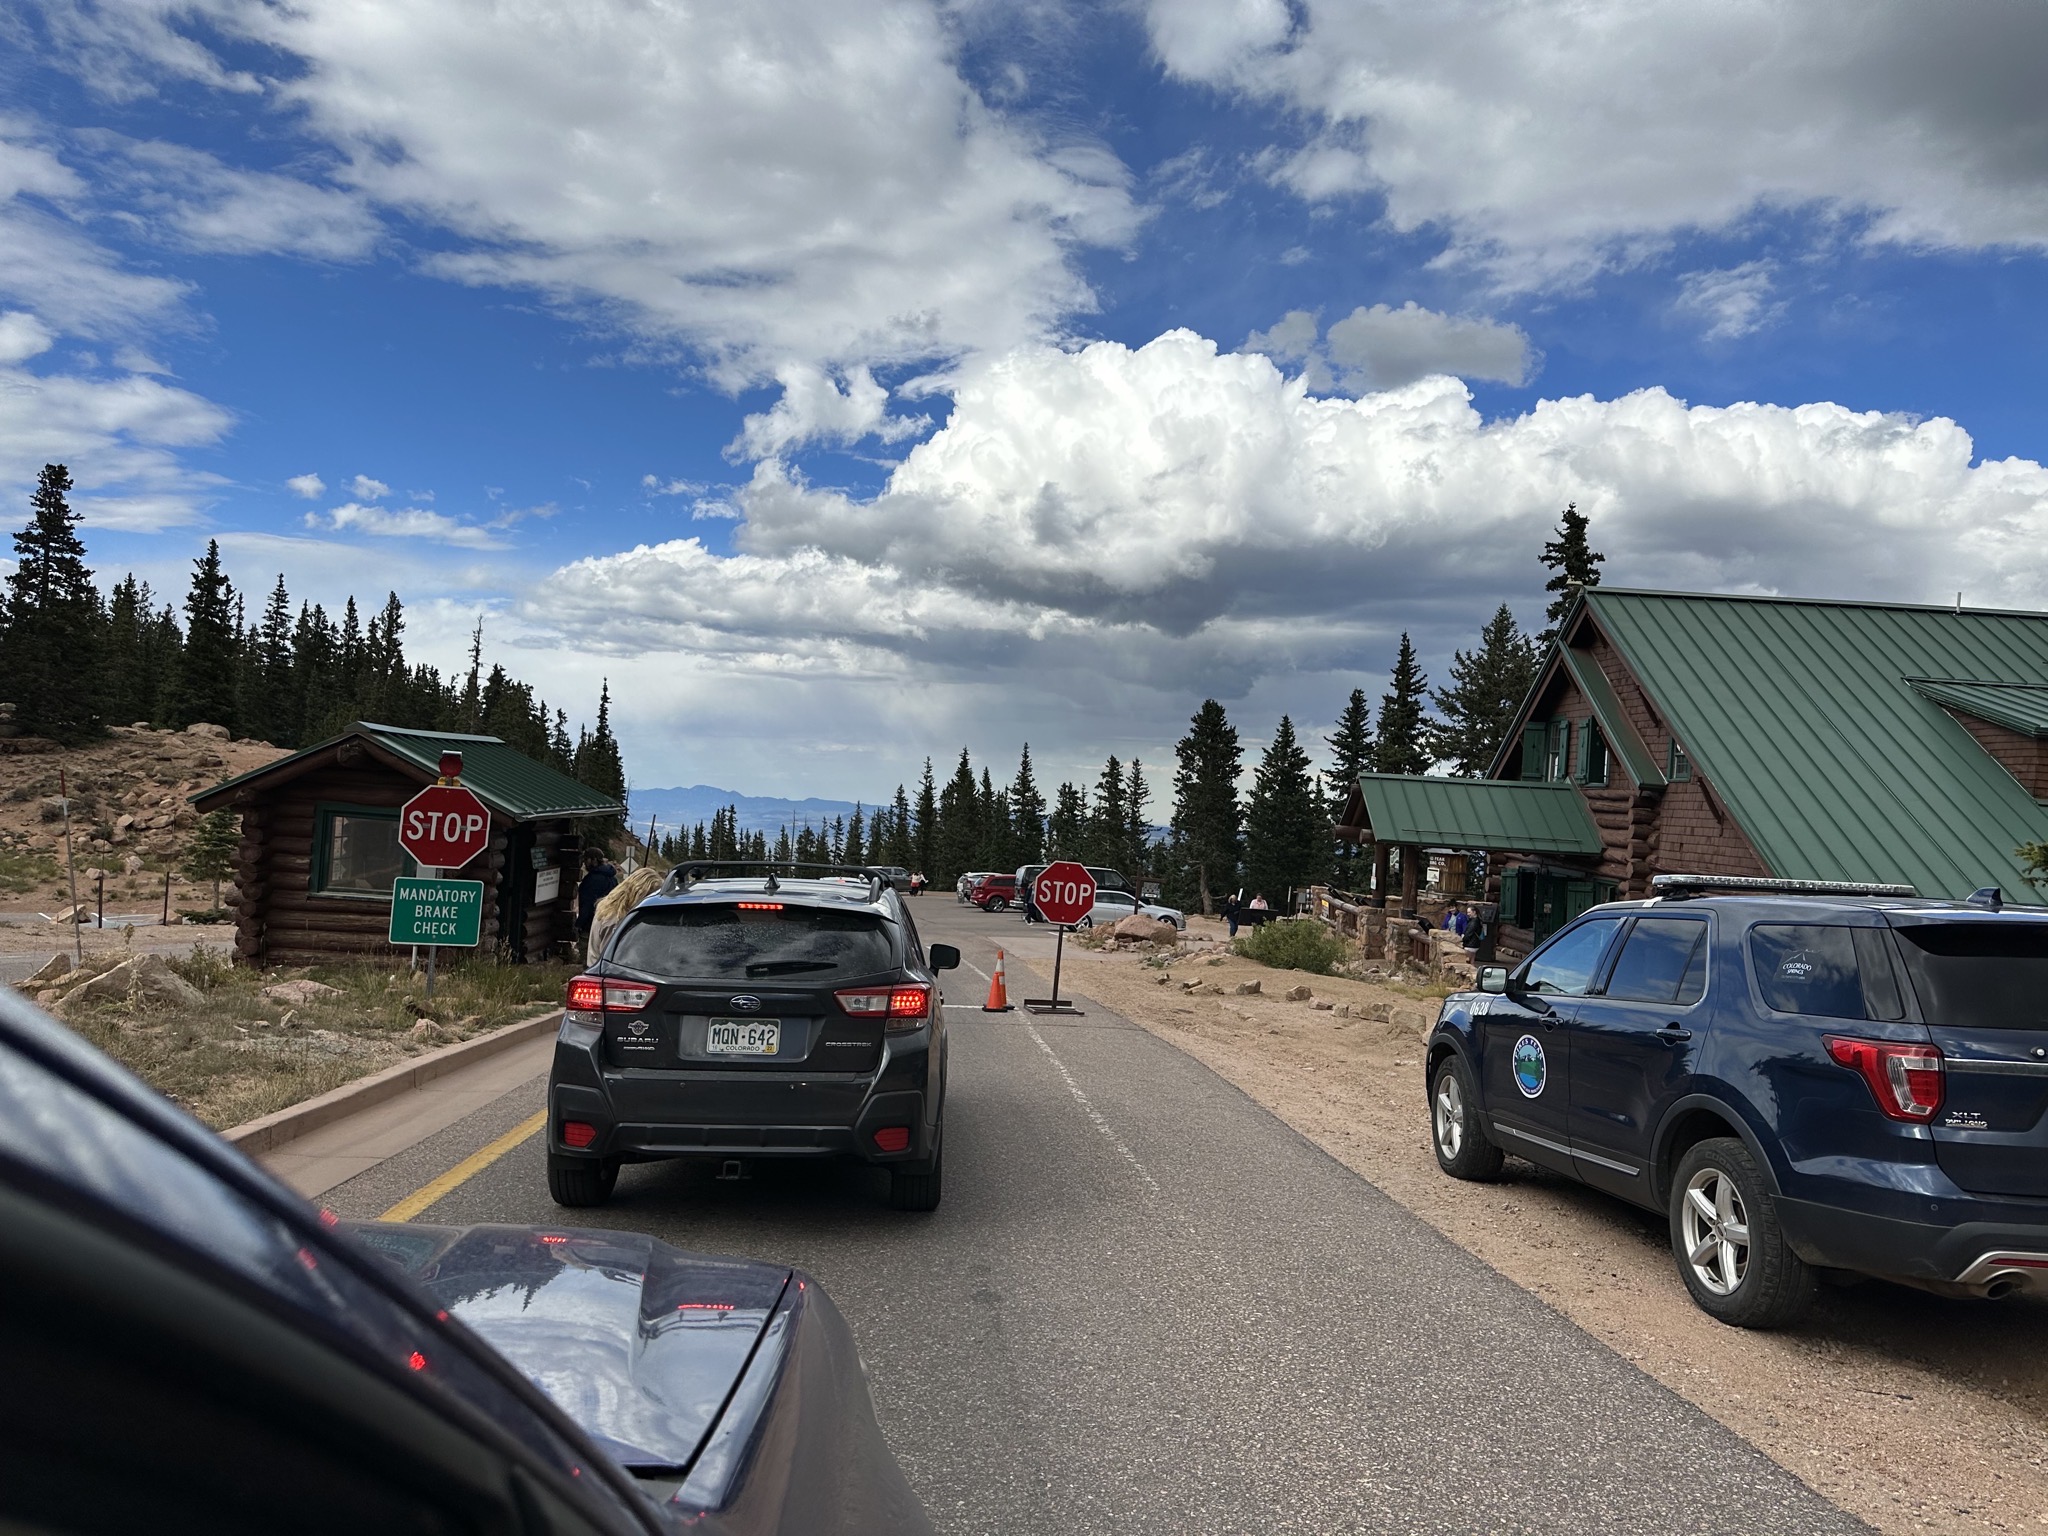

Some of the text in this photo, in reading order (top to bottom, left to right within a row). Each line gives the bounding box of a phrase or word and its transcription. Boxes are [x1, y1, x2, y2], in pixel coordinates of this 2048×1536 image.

[406, 810, 483, 843] STOP
[399, 888, 477, 903] MANDATORY
[1039, 880, 1091, 905] STOP
[415, 905, 459, 919] BRAKE
[413, 921, 457, 935] CHECK
[1782, 962, 1812, 972] COLORADO
[1470, 1001, 1490, 1016] 0628
[1952, 1111, 1981, 1119] XLT
